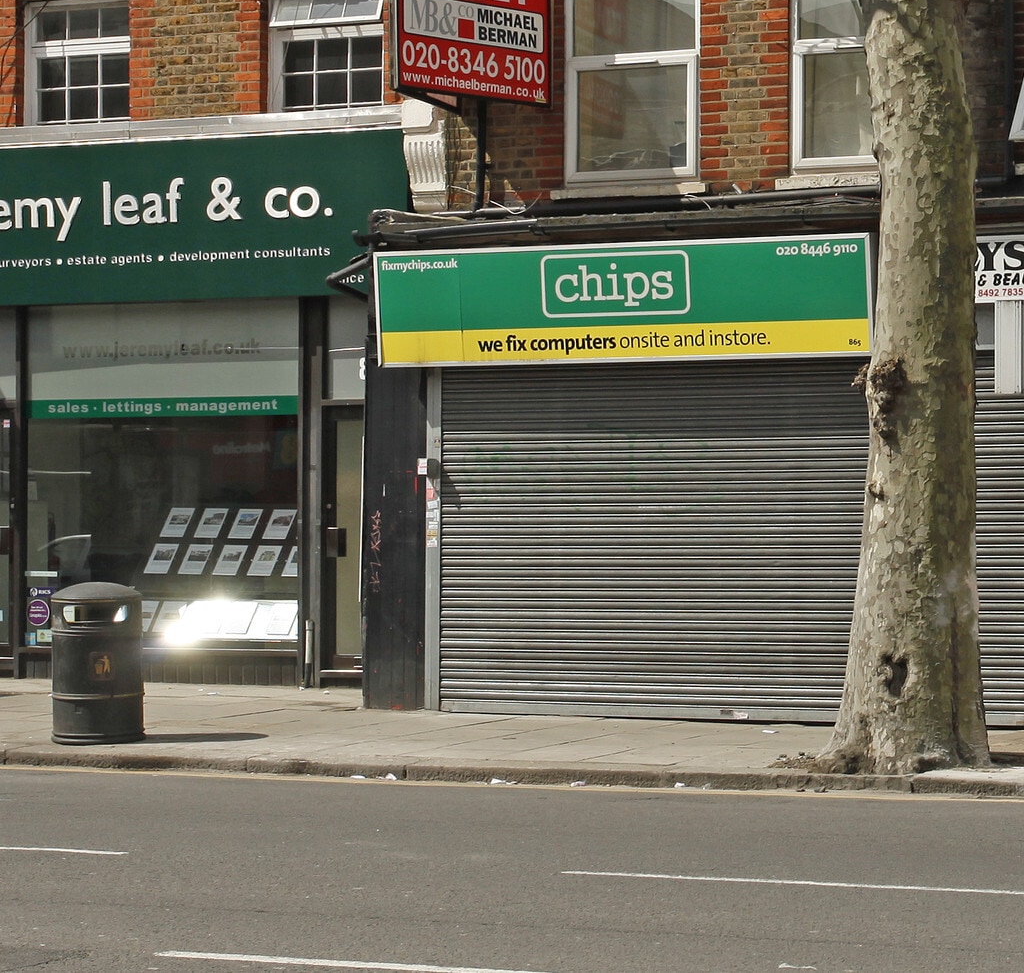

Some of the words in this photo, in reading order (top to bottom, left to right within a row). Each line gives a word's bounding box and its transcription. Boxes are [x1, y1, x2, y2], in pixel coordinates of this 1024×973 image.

[477, 8, 538, 32] MICHAEL
[478, 26, 537, 49] BERMAN
[402, 39, 499, 77] 020-8346
[504, 55, 545, 85] 5100
[402, 71, 545, 99] www.michaelberman.co.uk
[0, 196, 82, 242] emy
[102, 177, 184, 226] leaf
[206, 177, 243, 222] &
[264, 185, 334, 219] co.
[67, 254, 107, 266] estate
[111, 253, 152, 266] agents
[169, 249, 250, 263] development
[254, 246, 331, 259] consultants
[381, 258, 458, 273] fixmychips.co.uk
[776, 245, 798, 256] 020
[800, 243, 830, 257] 8446
[833, 243, 858, 257] 9110
[555, 263, 674, 307] chips
[978, 274, 987, 287] &
[978, 289, 999, 297] 8492
[1002, 288, 1024, 296] 7835
[62, 339, 262, 362] www.jeremyleaf.co.uk
[478, 339, 503, 353] we
[506, 335, 527, 351] fix
[530, 334, 616, 355] computers
[620, 331, 670, 349] onsite
[674, 329, 704, 347] and
[710, 329, 771, 346] instore.
[48, 402, 89, 414] sales
[102, 401, 162, 414] lettings
[176, 399, 278, 413] management
